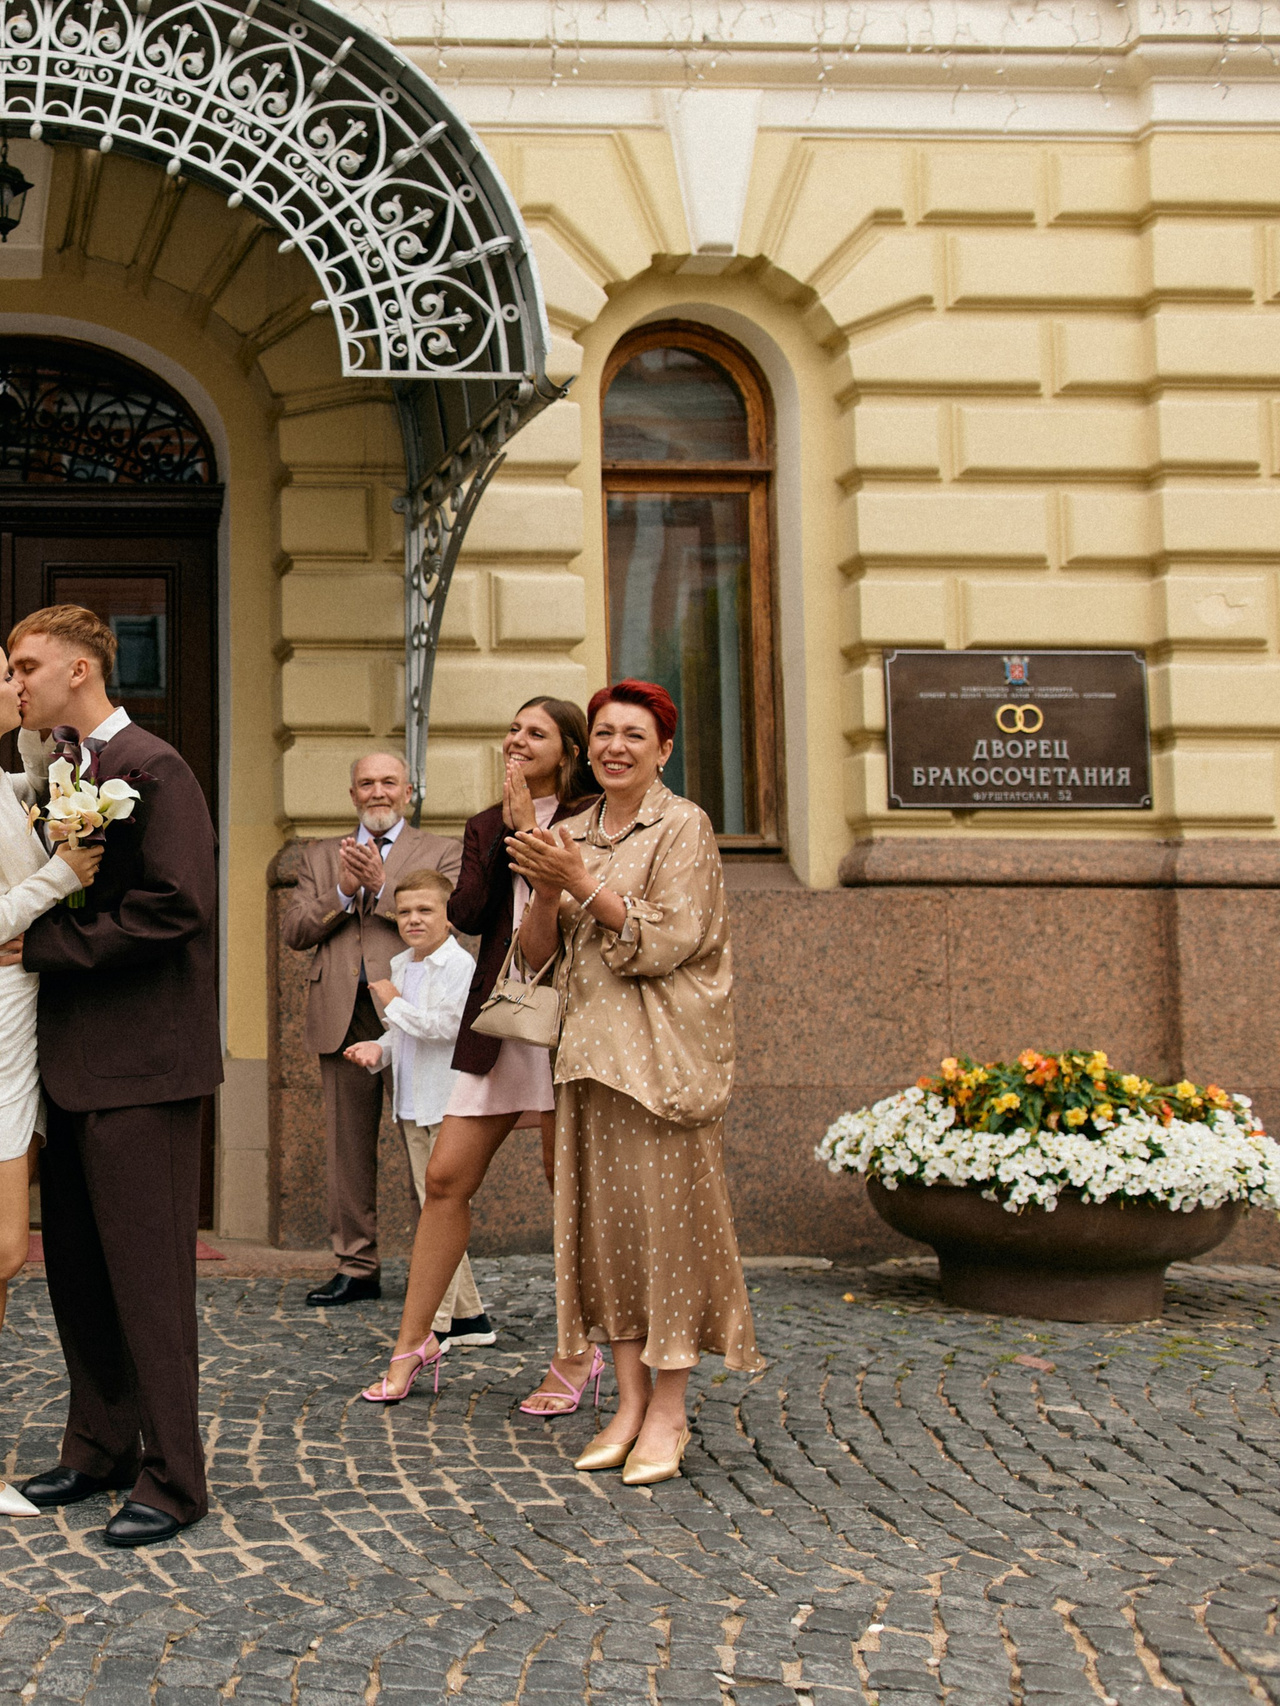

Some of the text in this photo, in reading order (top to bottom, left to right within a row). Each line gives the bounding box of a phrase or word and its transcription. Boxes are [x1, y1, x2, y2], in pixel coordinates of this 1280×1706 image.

[972, 739, 1070, 760] ДВОРЕЦ
[913, 766, 1131, 787] БРАКОСОЧЕТАНИЯ
[1057, 789, 1072, 801] 52
